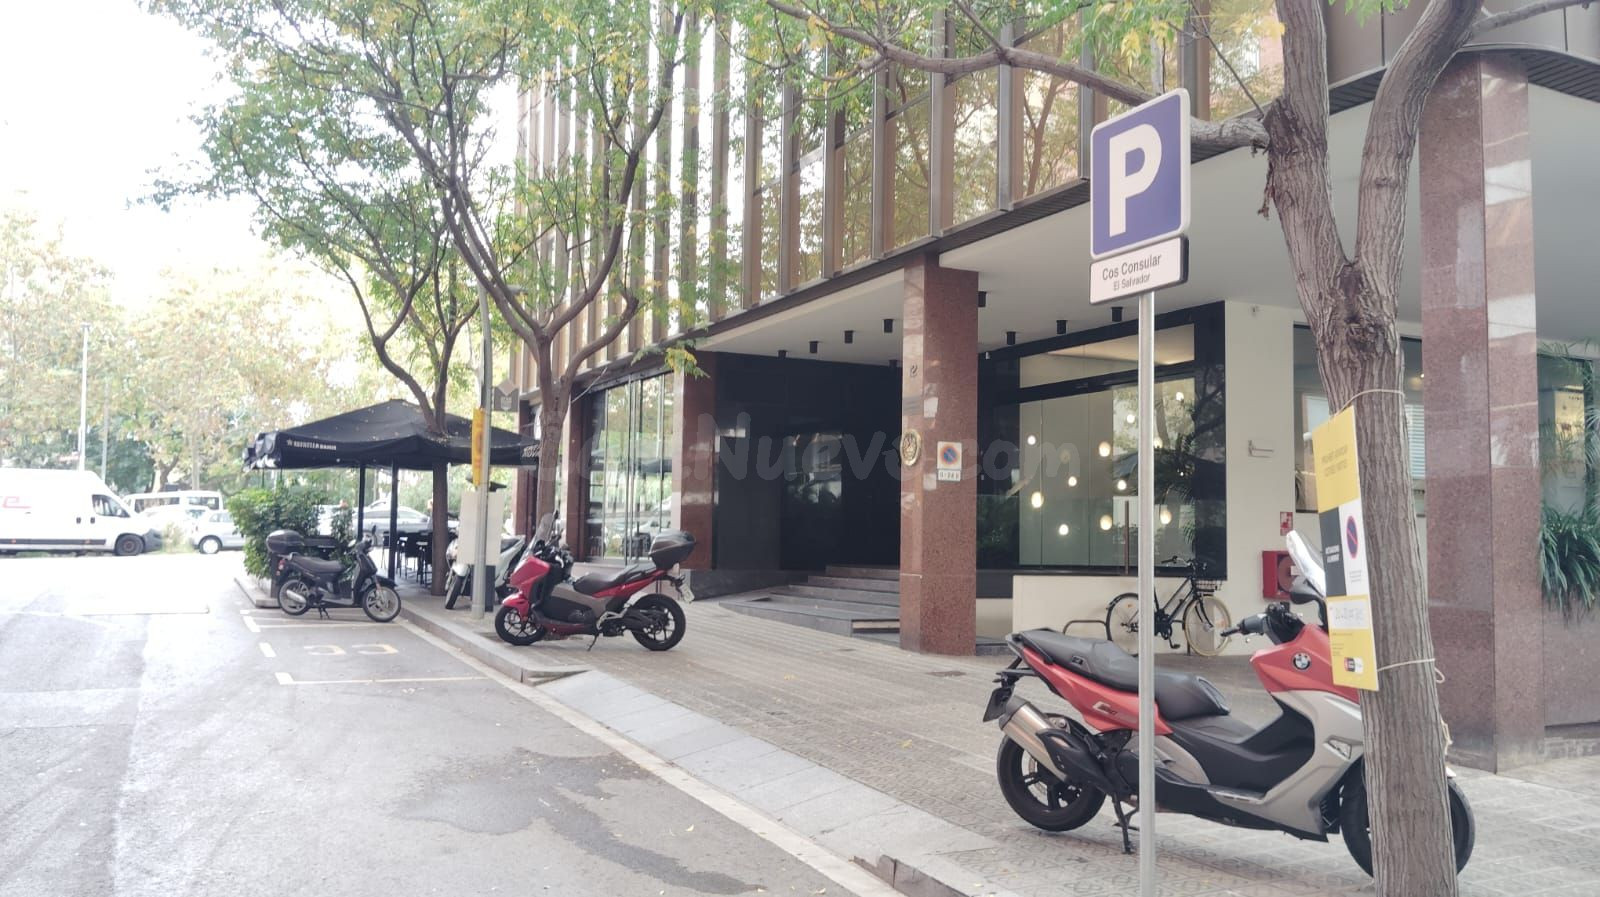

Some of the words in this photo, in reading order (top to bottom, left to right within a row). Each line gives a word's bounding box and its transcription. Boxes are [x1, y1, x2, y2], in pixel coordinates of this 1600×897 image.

[1110, 124, 1162, 237] P
[1102, 268, 1119, 280] Cos
[1121, 255, 1161, 275] Consular
[1121, 273, 1151, 289] Salvador
